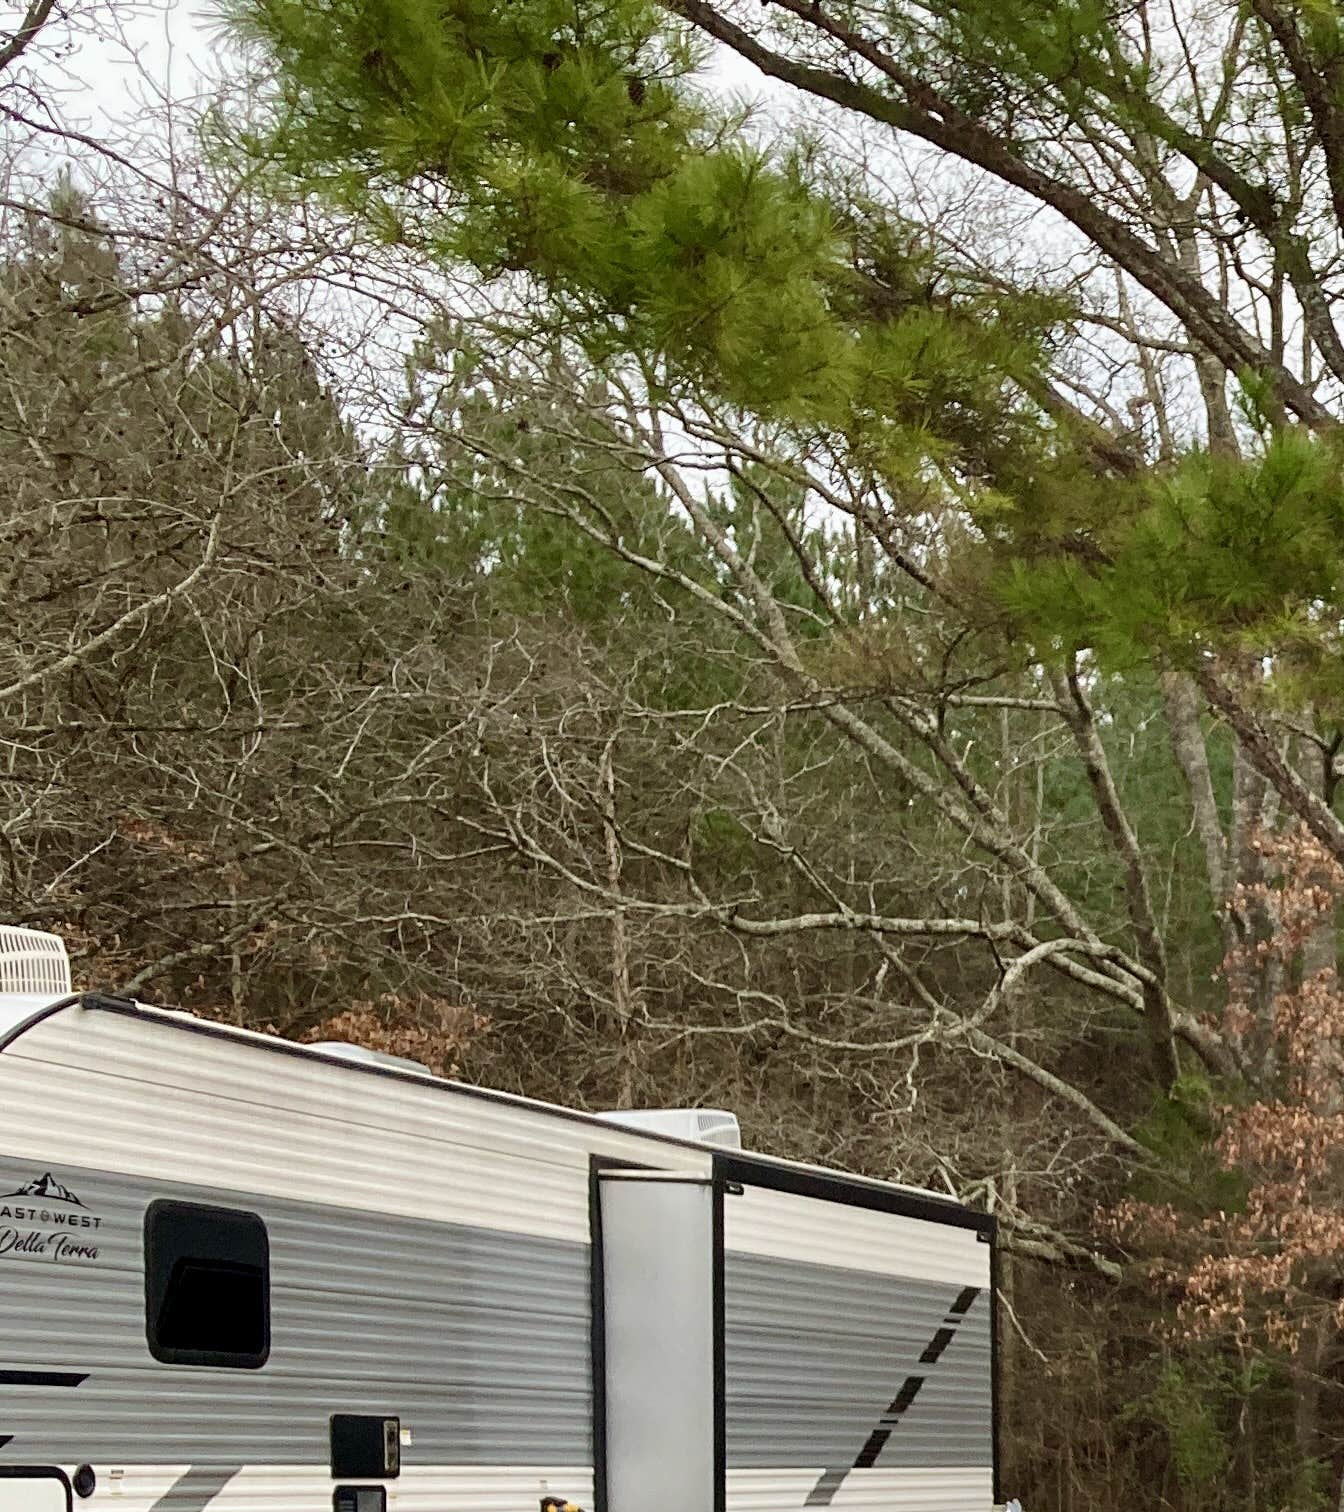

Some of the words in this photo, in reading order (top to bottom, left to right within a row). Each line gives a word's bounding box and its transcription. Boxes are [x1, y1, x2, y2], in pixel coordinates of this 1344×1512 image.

[0, 1206, 36, 1220] AST
[54, 1213, 102, 1229] WEST
[0, 1225, 45, 1253] Della
[48, 1231, 98, 1260] Terra
